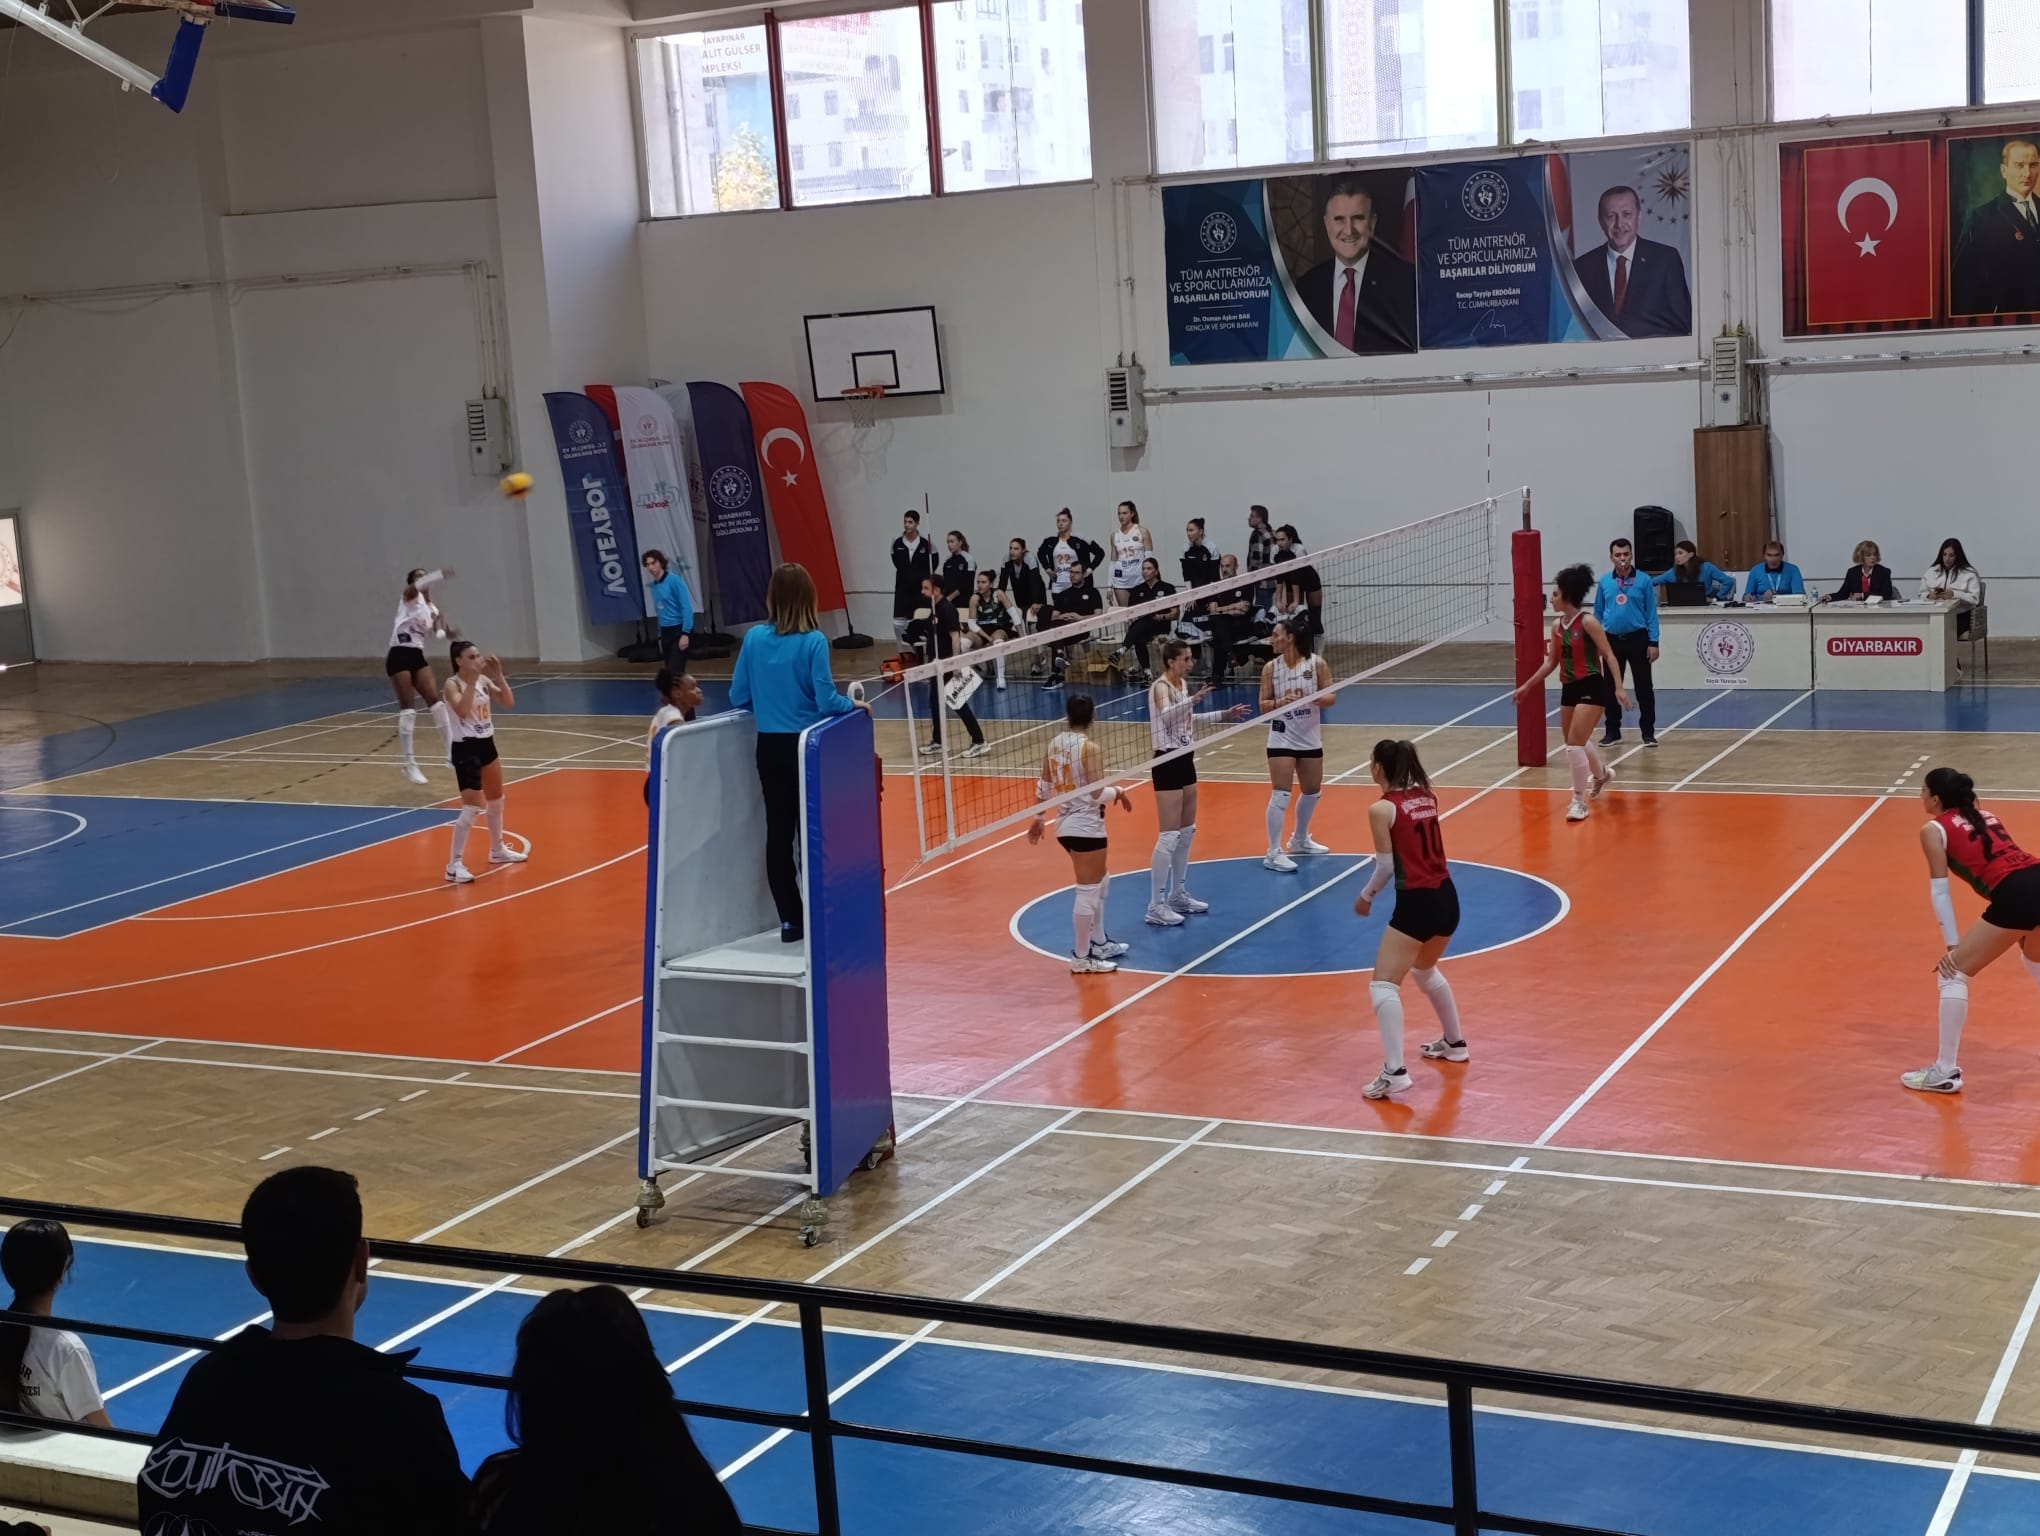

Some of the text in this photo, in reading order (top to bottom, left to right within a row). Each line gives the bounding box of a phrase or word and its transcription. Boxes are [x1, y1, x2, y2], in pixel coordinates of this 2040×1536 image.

[1448, 231, 1526, 251] TÜM ANTRENÖR
[1437, 246, 1538, 265] VE SPORCULARIMIZA
[1180, 264, 1261, 281] TÜM ANTRENÖR
[1439, 262, 1536, 280] BAŞARILAR DİLİYORUM
[1169, 276, 1273, 293] VE SPORCULARIMIZA
[1173, 289, 1270, 304] BAŞARILAR DİLİYORUM
[1832, 639, 1917, 653] DİYARBAKIR
